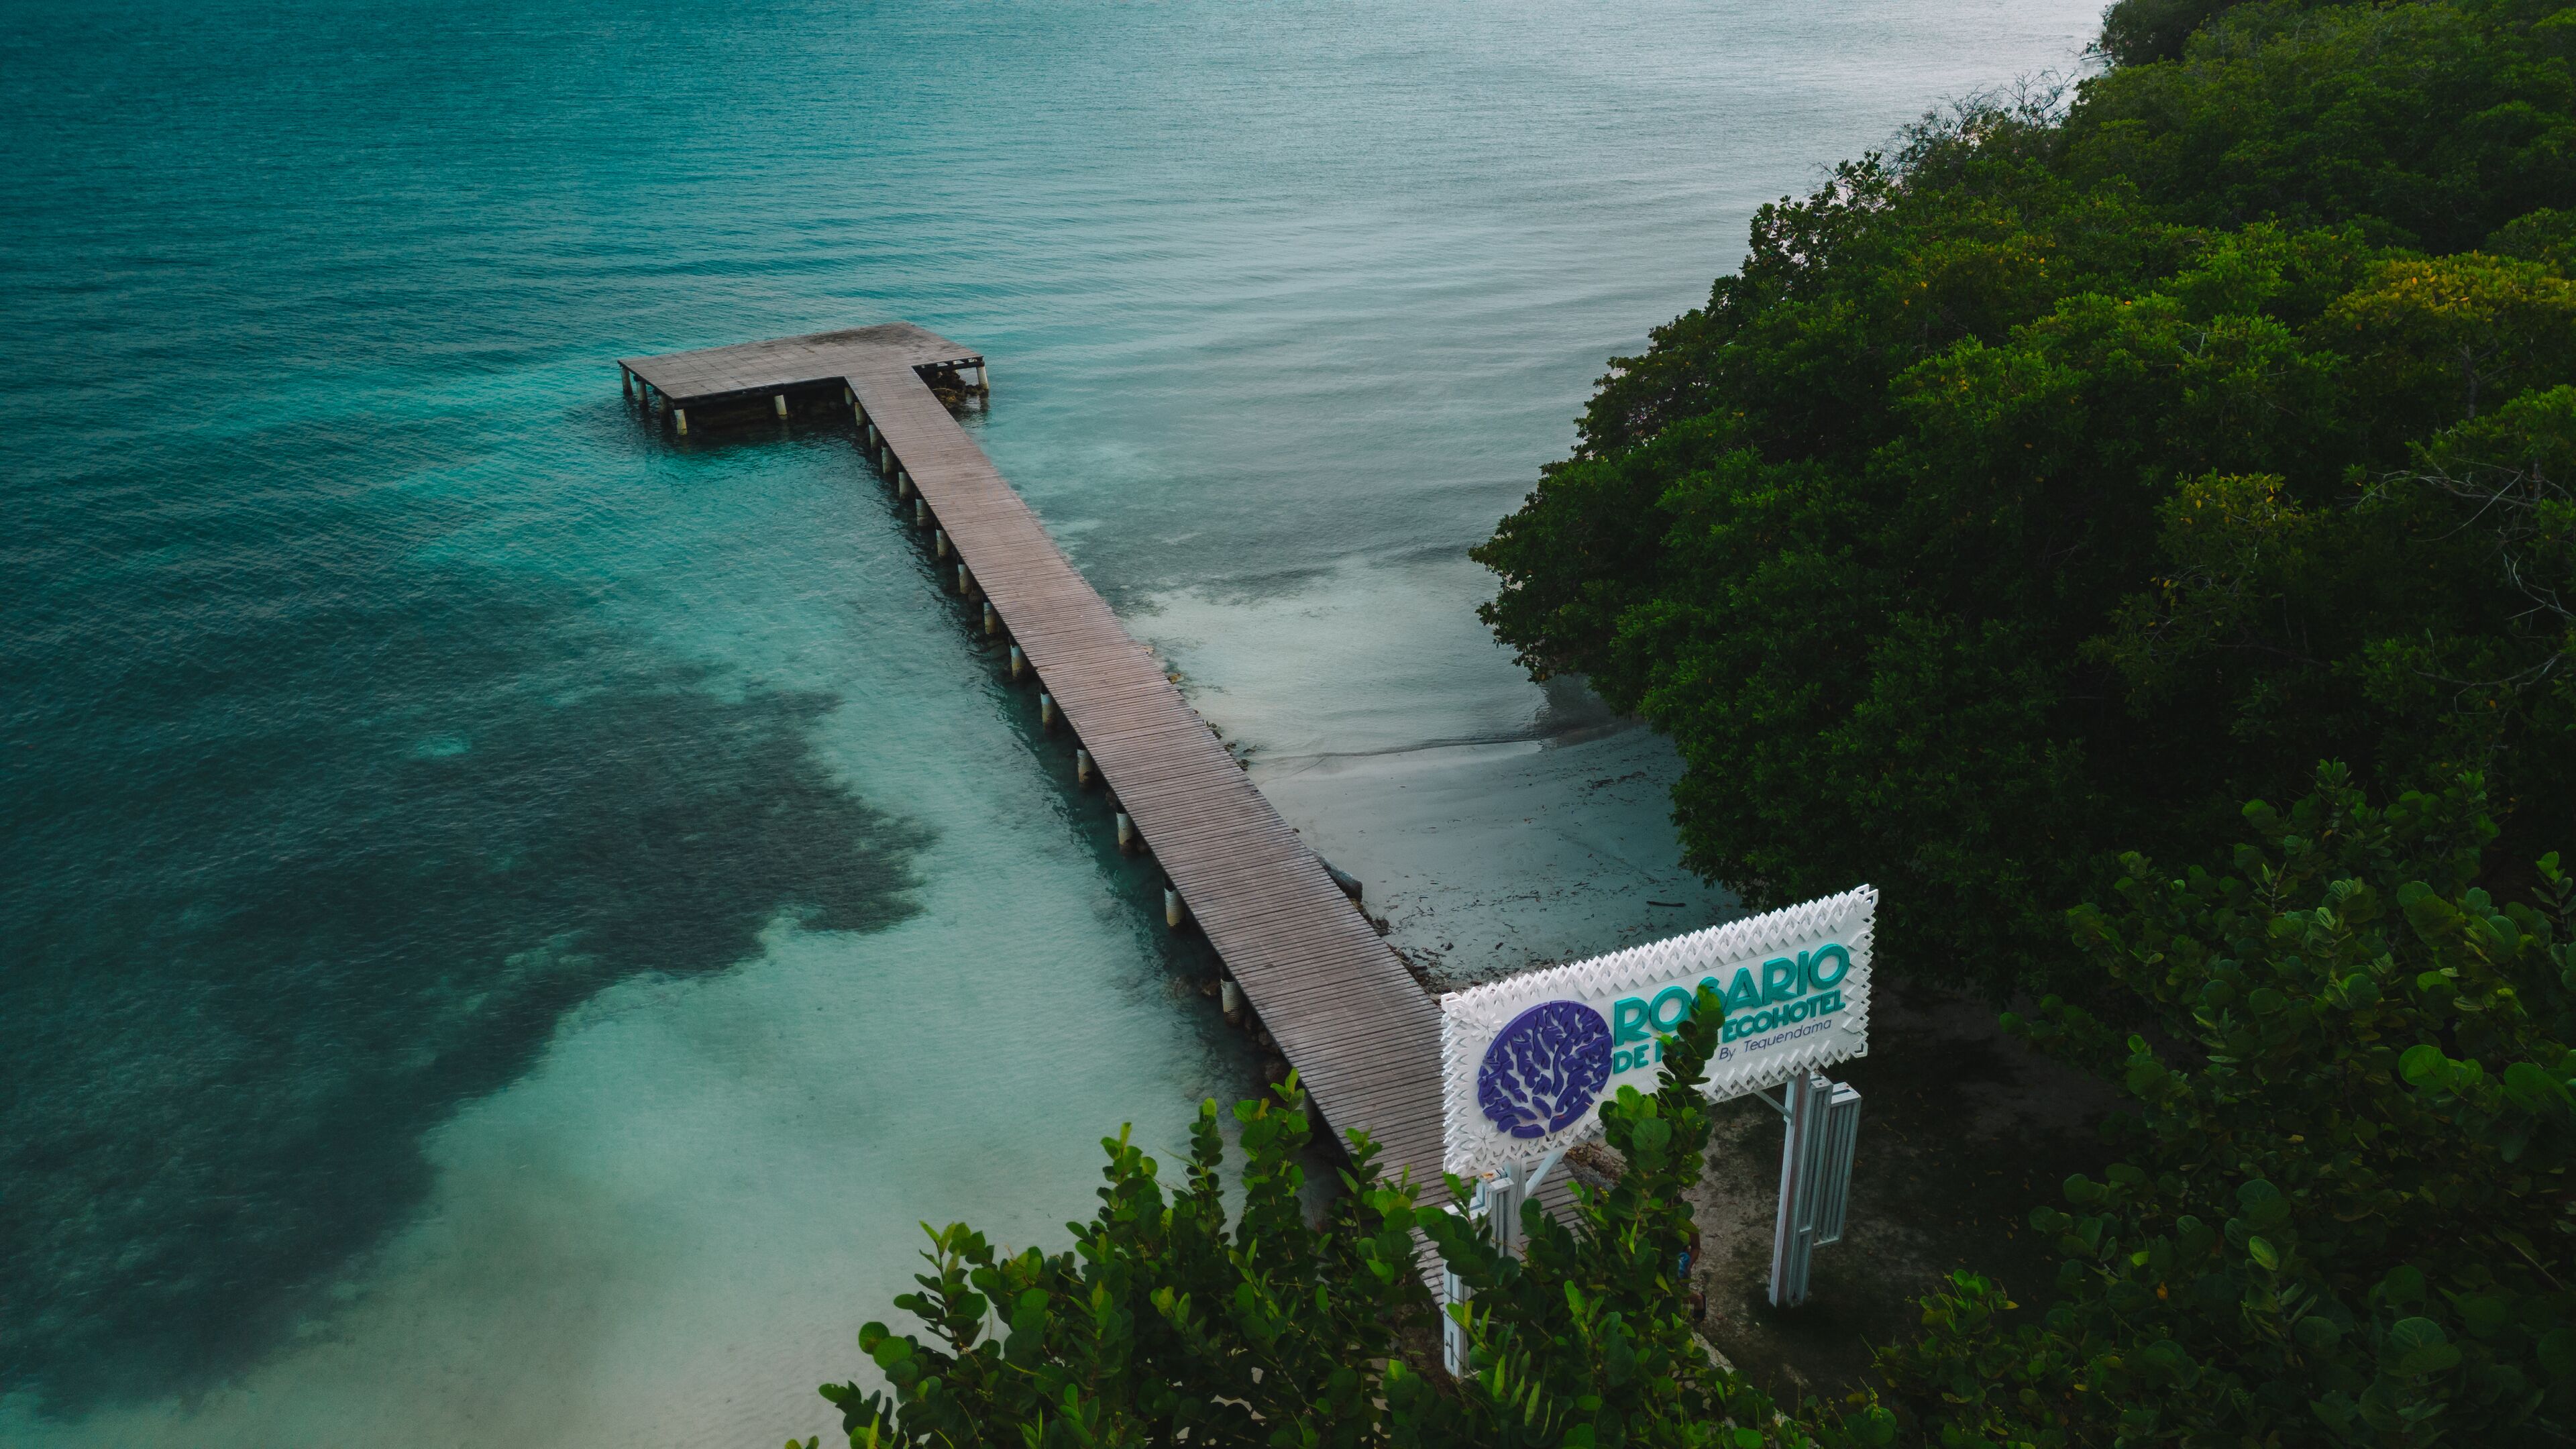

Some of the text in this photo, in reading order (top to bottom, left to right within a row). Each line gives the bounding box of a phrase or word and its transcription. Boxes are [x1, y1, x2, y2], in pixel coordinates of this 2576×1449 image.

[1613, 1044, 1650, 1075] DE
[1721, 989, 1846, 1044] ECOHOTEL
[1719, 1019, 1833, 1062] By Tequendama
